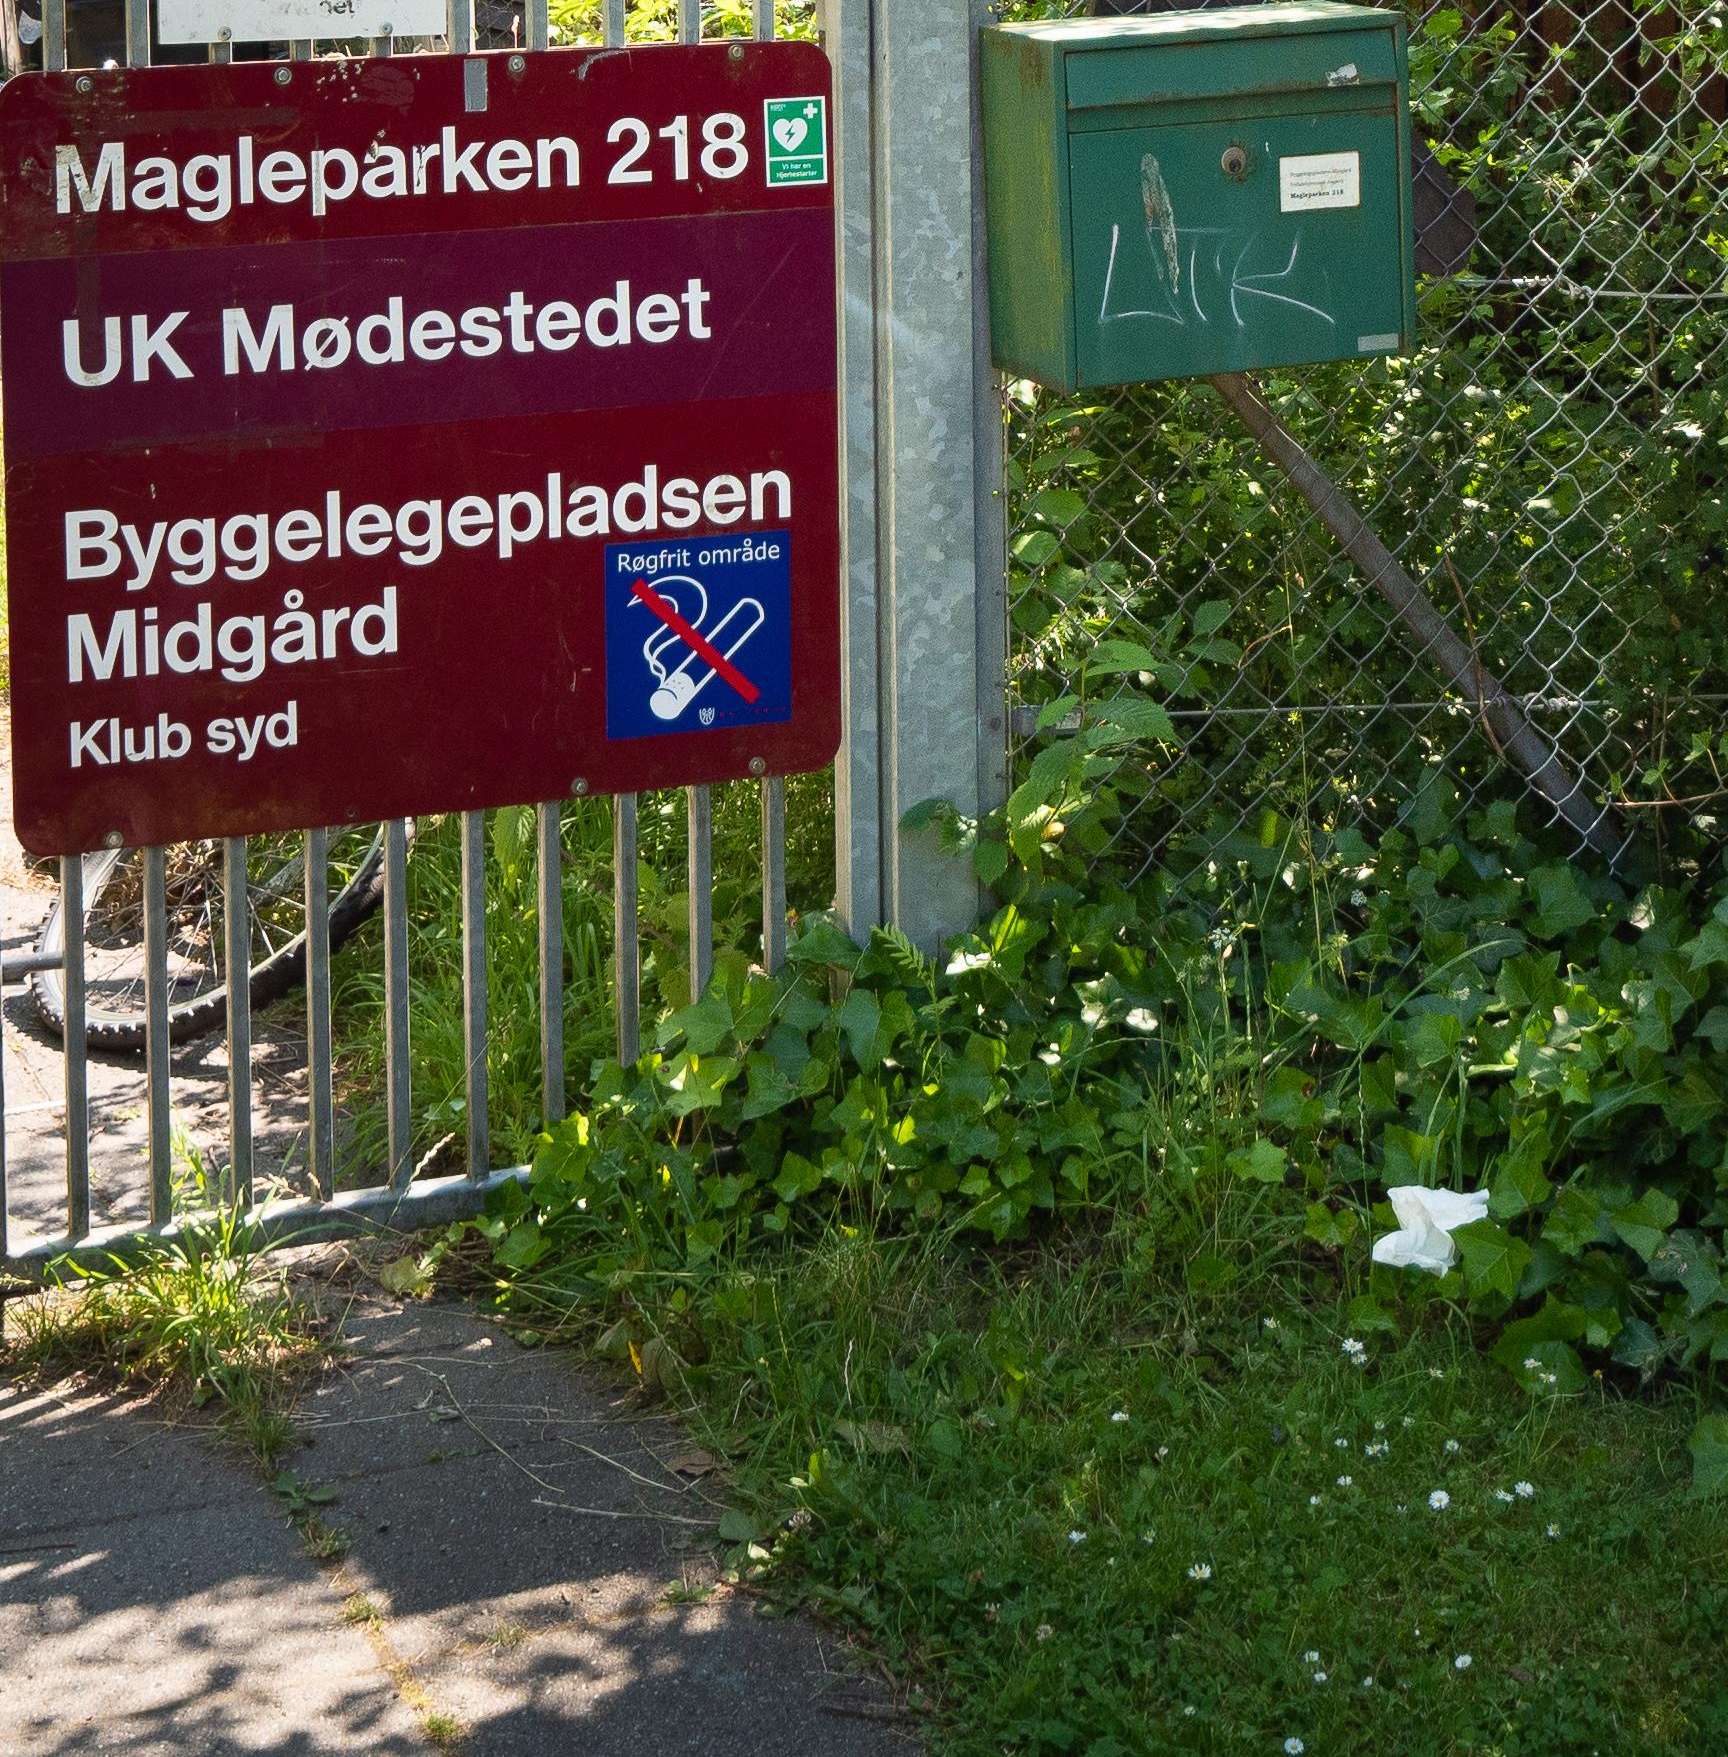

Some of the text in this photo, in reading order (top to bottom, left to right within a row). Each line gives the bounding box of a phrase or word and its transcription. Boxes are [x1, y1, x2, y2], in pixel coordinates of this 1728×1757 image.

[56, 112, 749, 222] Magleparken 218
[62, 278, 712, 387] UK Mødestedet
[65, 464, 792, 591] Byggelegepladsen
[617, 537, 780, 575] Røgfrit område
[67, 585, 398, 683] Midgård
[70, 700, 298, 768] Klub syd
